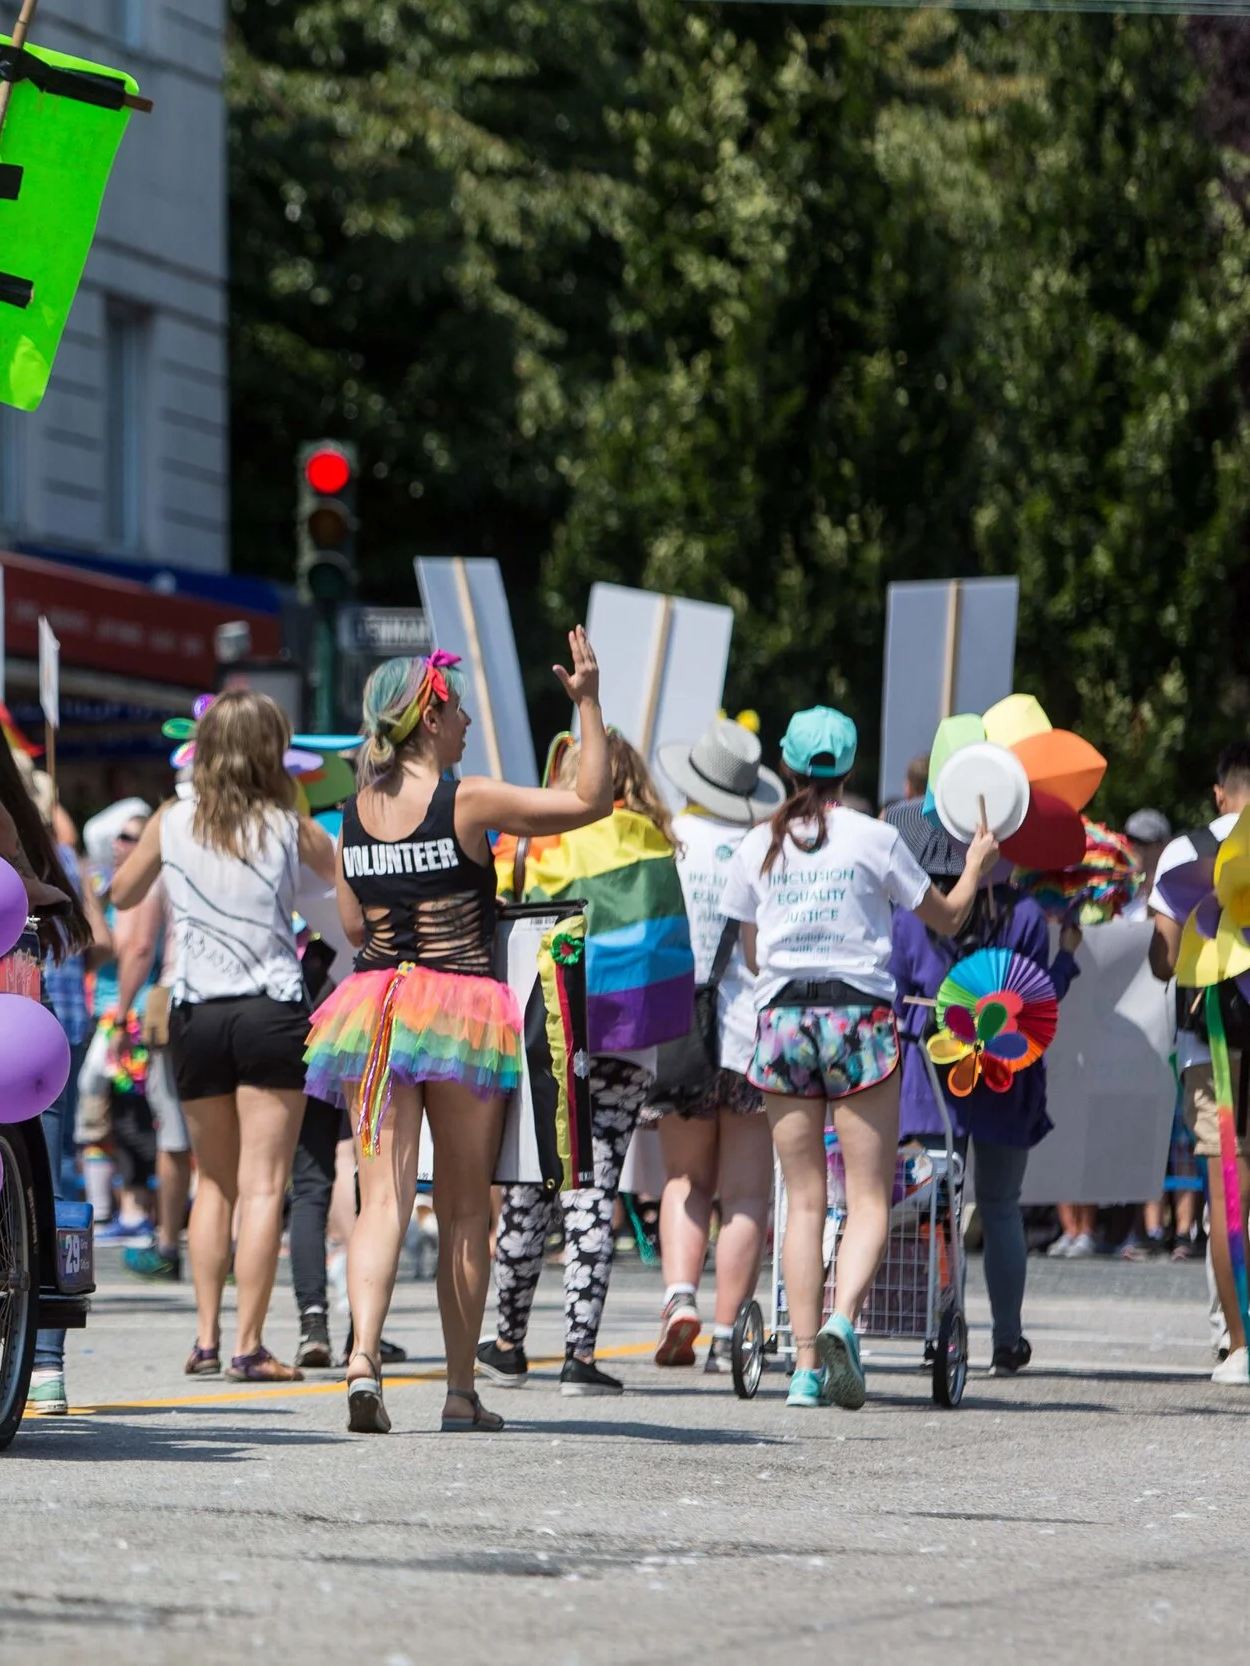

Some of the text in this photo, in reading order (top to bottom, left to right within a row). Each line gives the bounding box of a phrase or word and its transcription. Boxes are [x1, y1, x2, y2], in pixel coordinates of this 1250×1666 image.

[343, 837, 459, 878] VOLUNTEER
[772, 868, 855, 886] INCLUSION
[777, 887, 846, 906] EQUALITY
[785, 908, 839, 923] JUSTICE
[65, 1234, 80, 1274] 29
